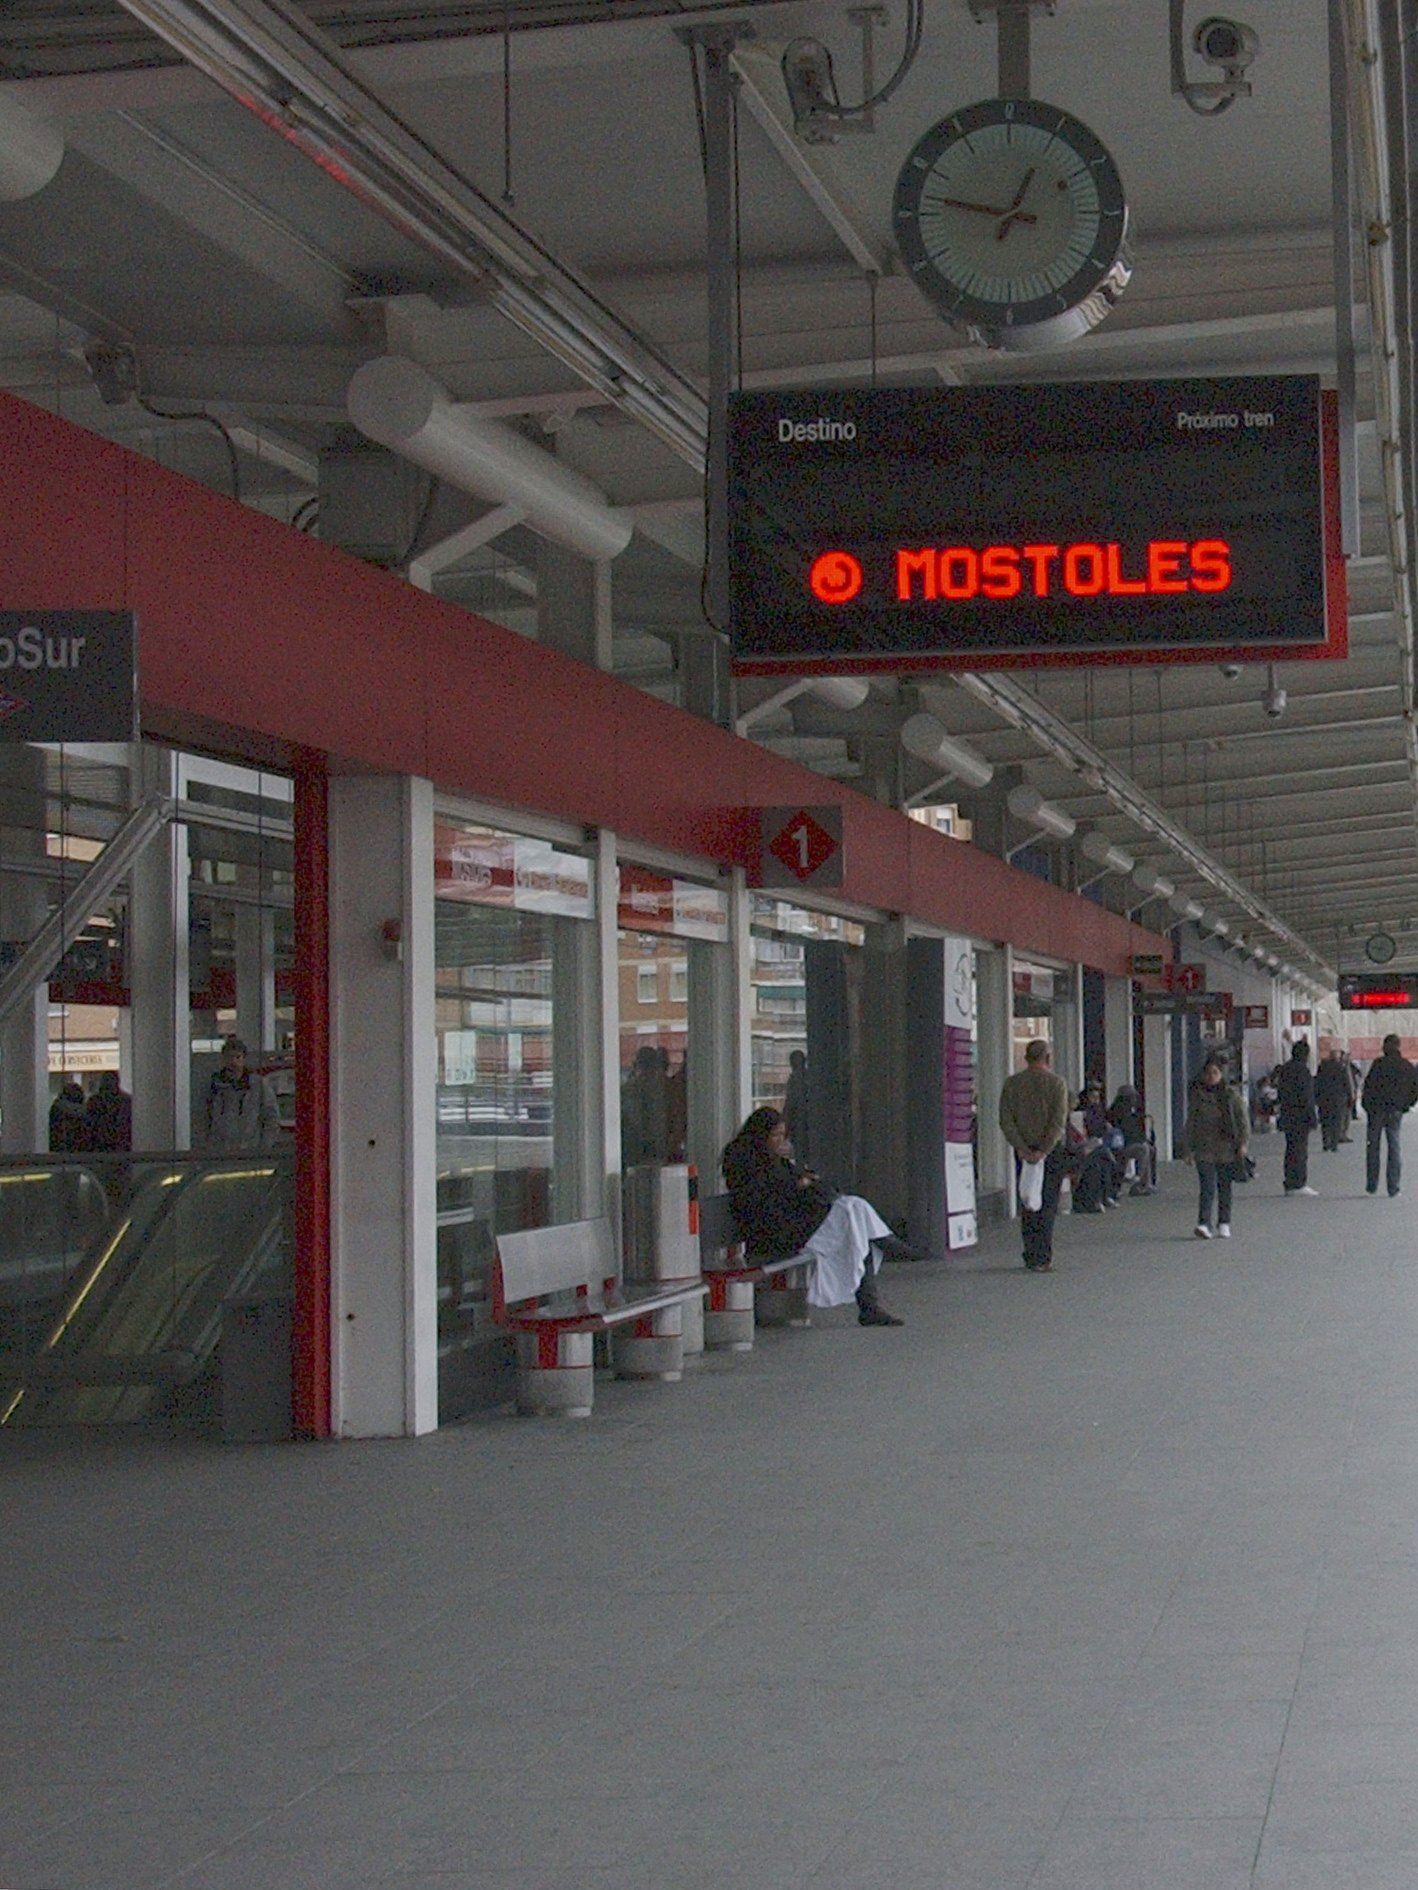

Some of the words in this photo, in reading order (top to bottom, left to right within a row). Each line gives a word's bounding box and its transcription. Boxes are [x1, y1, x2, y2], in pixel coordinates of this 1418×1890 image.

[778, 417, 857, 442] Destino
[1244, 409, 1275, 427] tren
[897, 539, 1233, 600] MOSTOLES
[790, 825, 809, 868] 1
